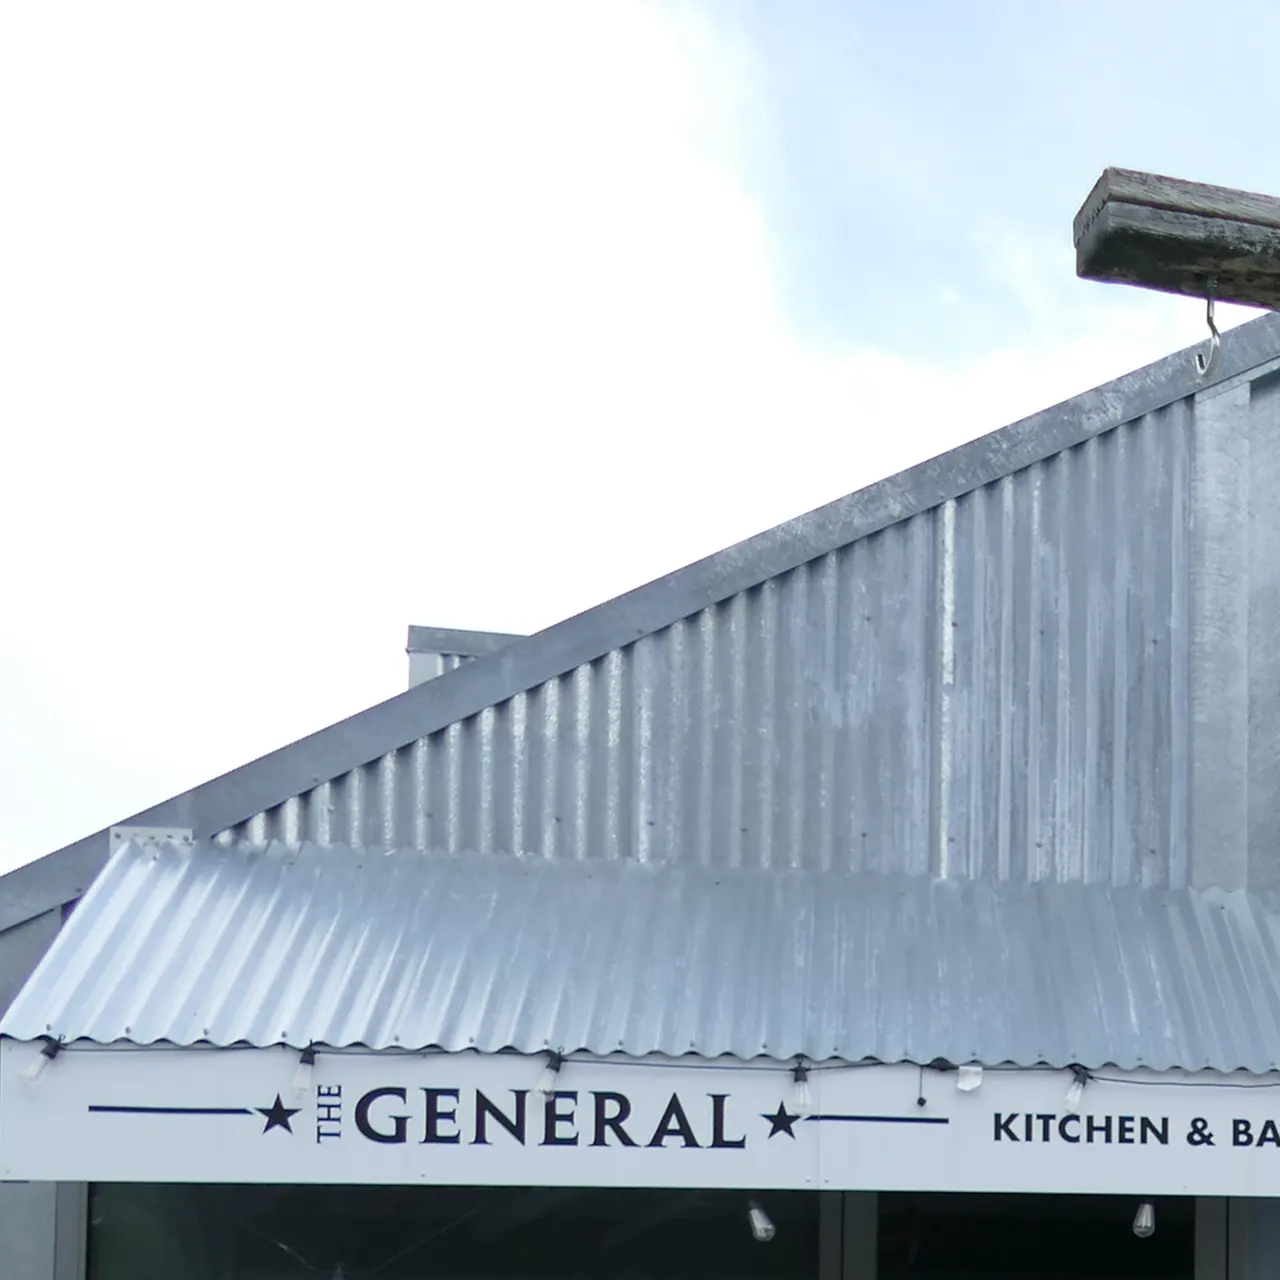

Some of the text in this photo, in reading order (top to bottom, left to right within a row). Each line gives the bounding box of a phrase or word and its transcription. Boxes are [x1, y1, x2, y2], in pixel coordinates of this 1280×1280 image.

[316, 1084, 342, 1144] THE
[354, 1086, 746, 1149] GENERAL
[993, 1112, 1170, 1145] KITCHEN
[1185, 1117, 1217, 1146] &
